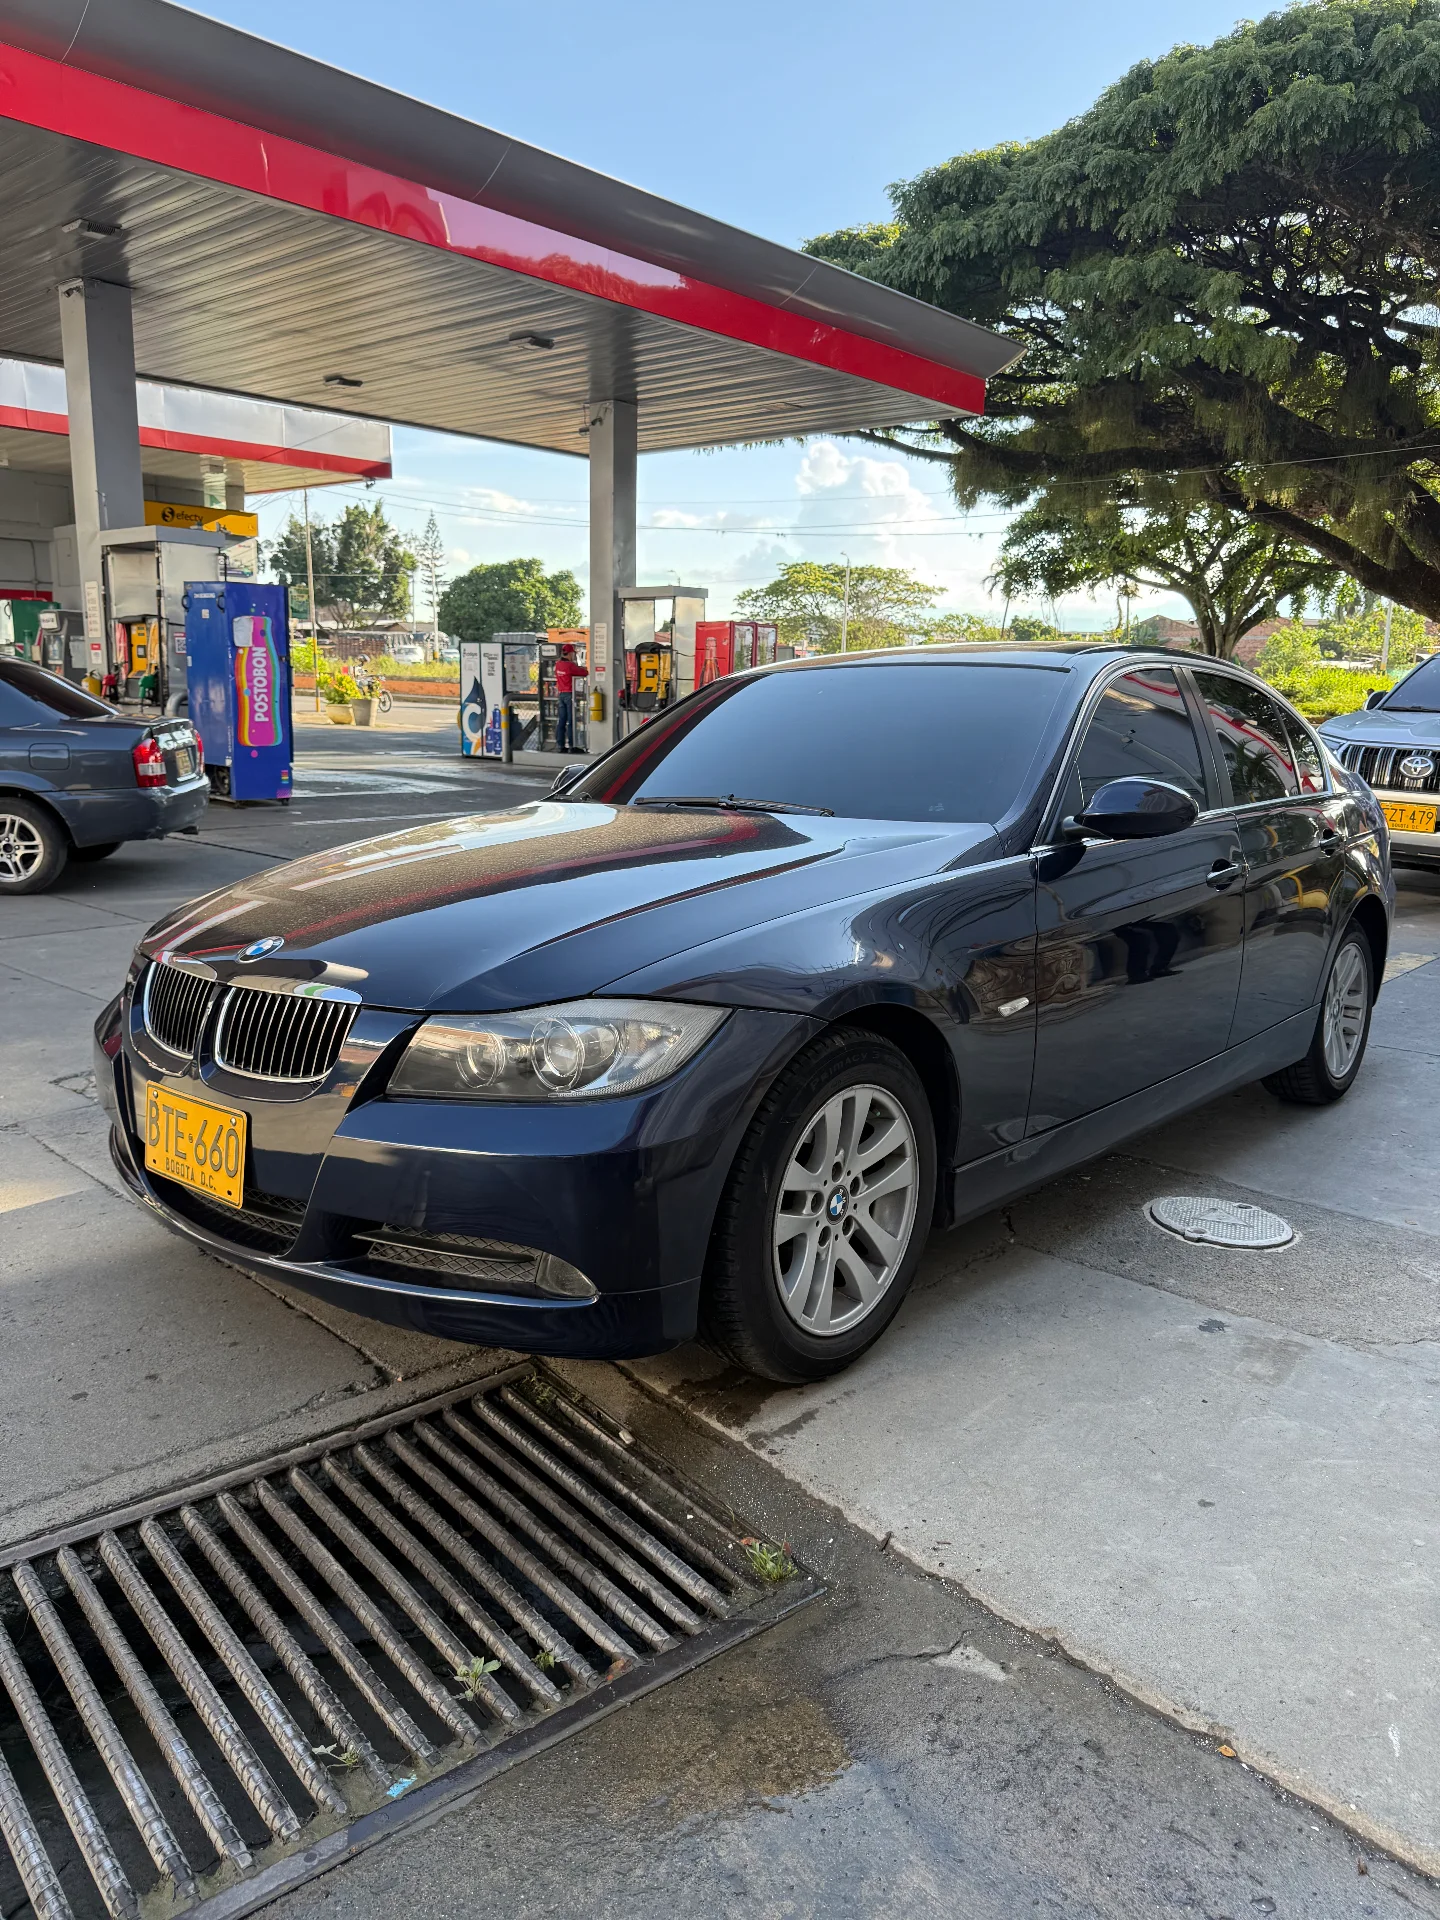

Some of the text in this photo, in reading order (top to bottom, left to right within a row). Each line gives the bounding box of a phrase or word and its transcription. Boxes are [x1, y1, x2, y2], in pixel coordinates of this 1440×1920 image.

[176, 510, 204, 521] efecty
[252, 646, 270, 722] POSTOBON
[1409, 810, 1434, 825] 479
[809, 1051, 868, 1092] PRIMACY
[872, 1050, 880, 1059] 3
[149, 1099, 240, 1178] BTE 660
[165, 1157, 217, 1191] BOGOTA D.C.
